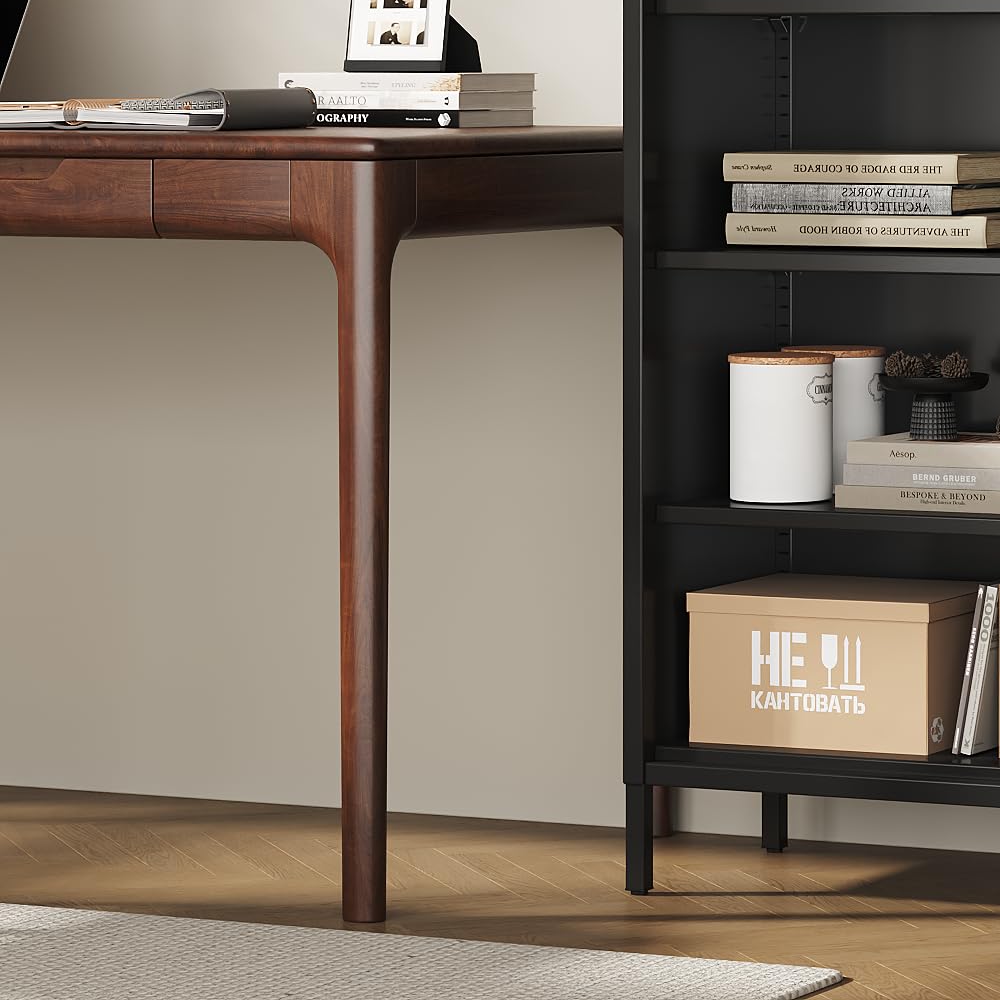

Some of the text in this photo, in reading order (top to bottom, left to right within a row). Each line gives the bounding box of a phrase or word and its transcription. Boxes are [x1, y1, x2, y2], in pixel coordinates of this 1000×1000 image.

[329, 96, 367, 106] AALTO
[316, 114, 369, 123] OGRAPHY
[913, 473, 976, 483] BERND GRUBER
[900, 491, 939, 499] BESPOKE
[950, 493, 985, 501] BEYOND
[981, 594, 994, 641] 1000
[751, 691, 865, 714] КАНТОВАТЬ
